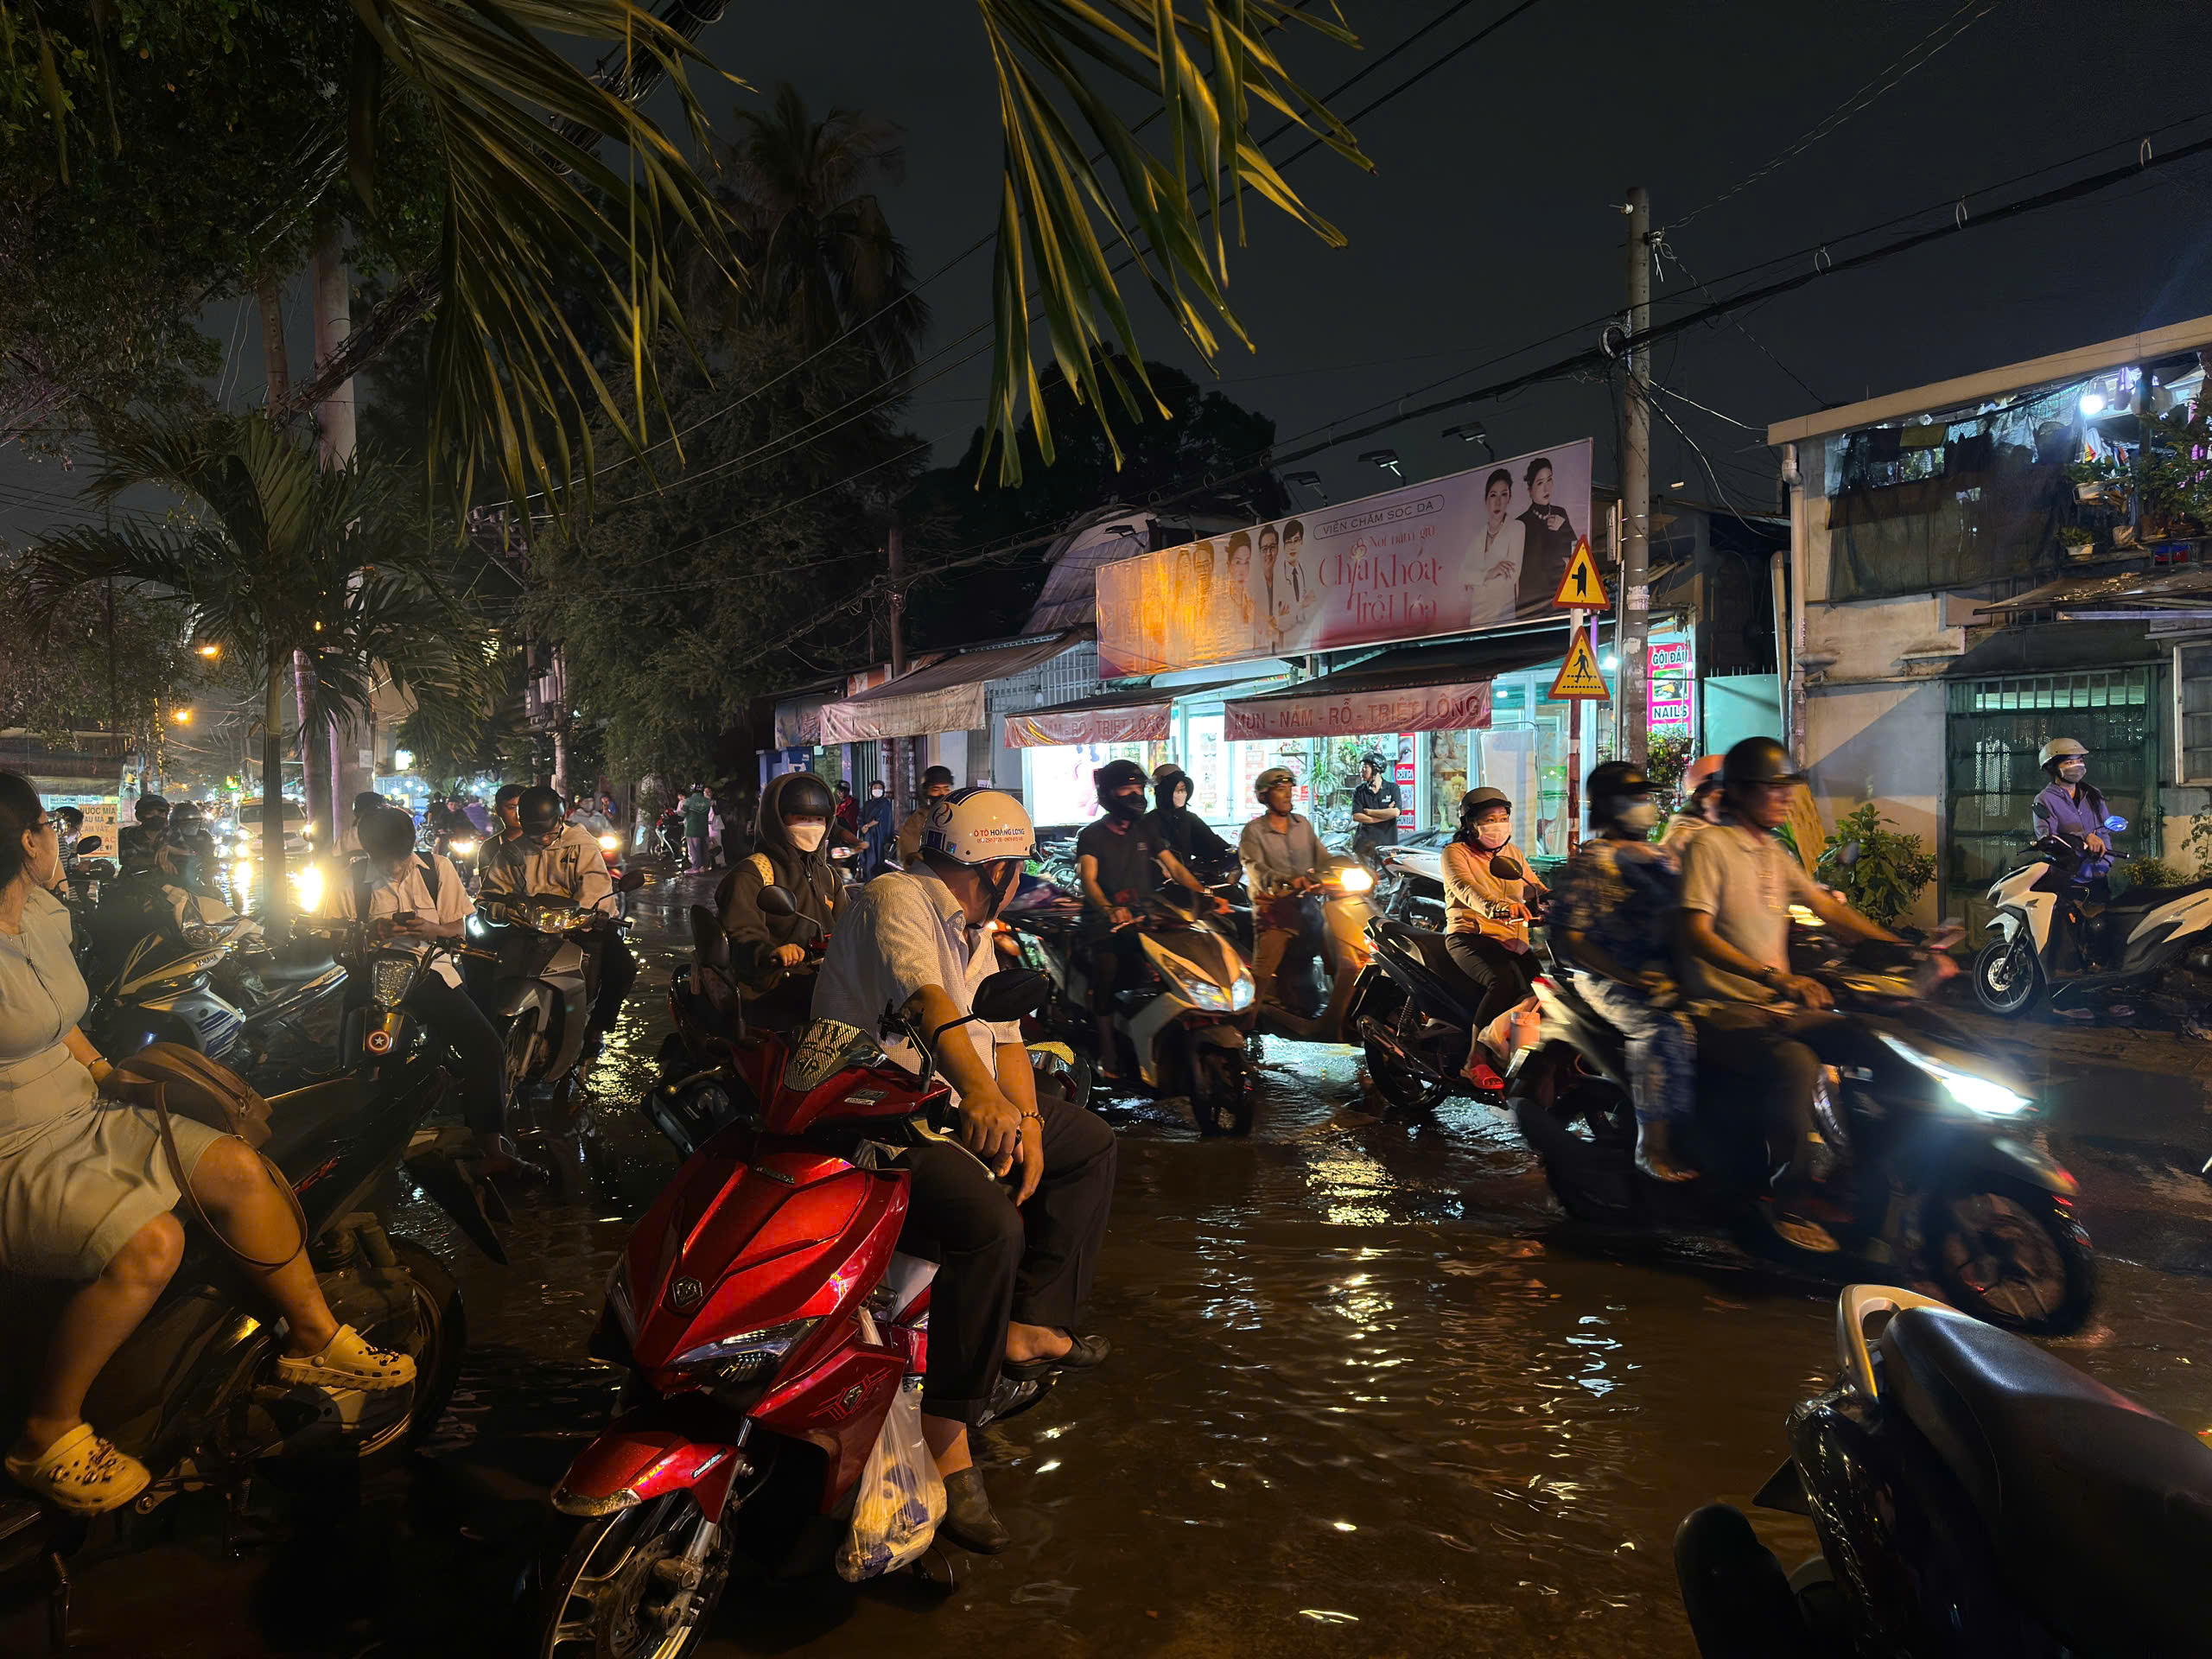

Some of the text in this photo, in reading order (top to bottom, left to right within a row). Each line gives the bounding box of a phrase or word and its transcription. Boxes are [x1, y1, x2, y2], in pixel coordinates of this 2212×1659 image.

[1417, 501, 1433, 512] DA
[1652, 651, 1669, 667] GỘI
[1426, 693, 1480, 720] LÔNG
[1654, 706, 1688, 719] NAILS
